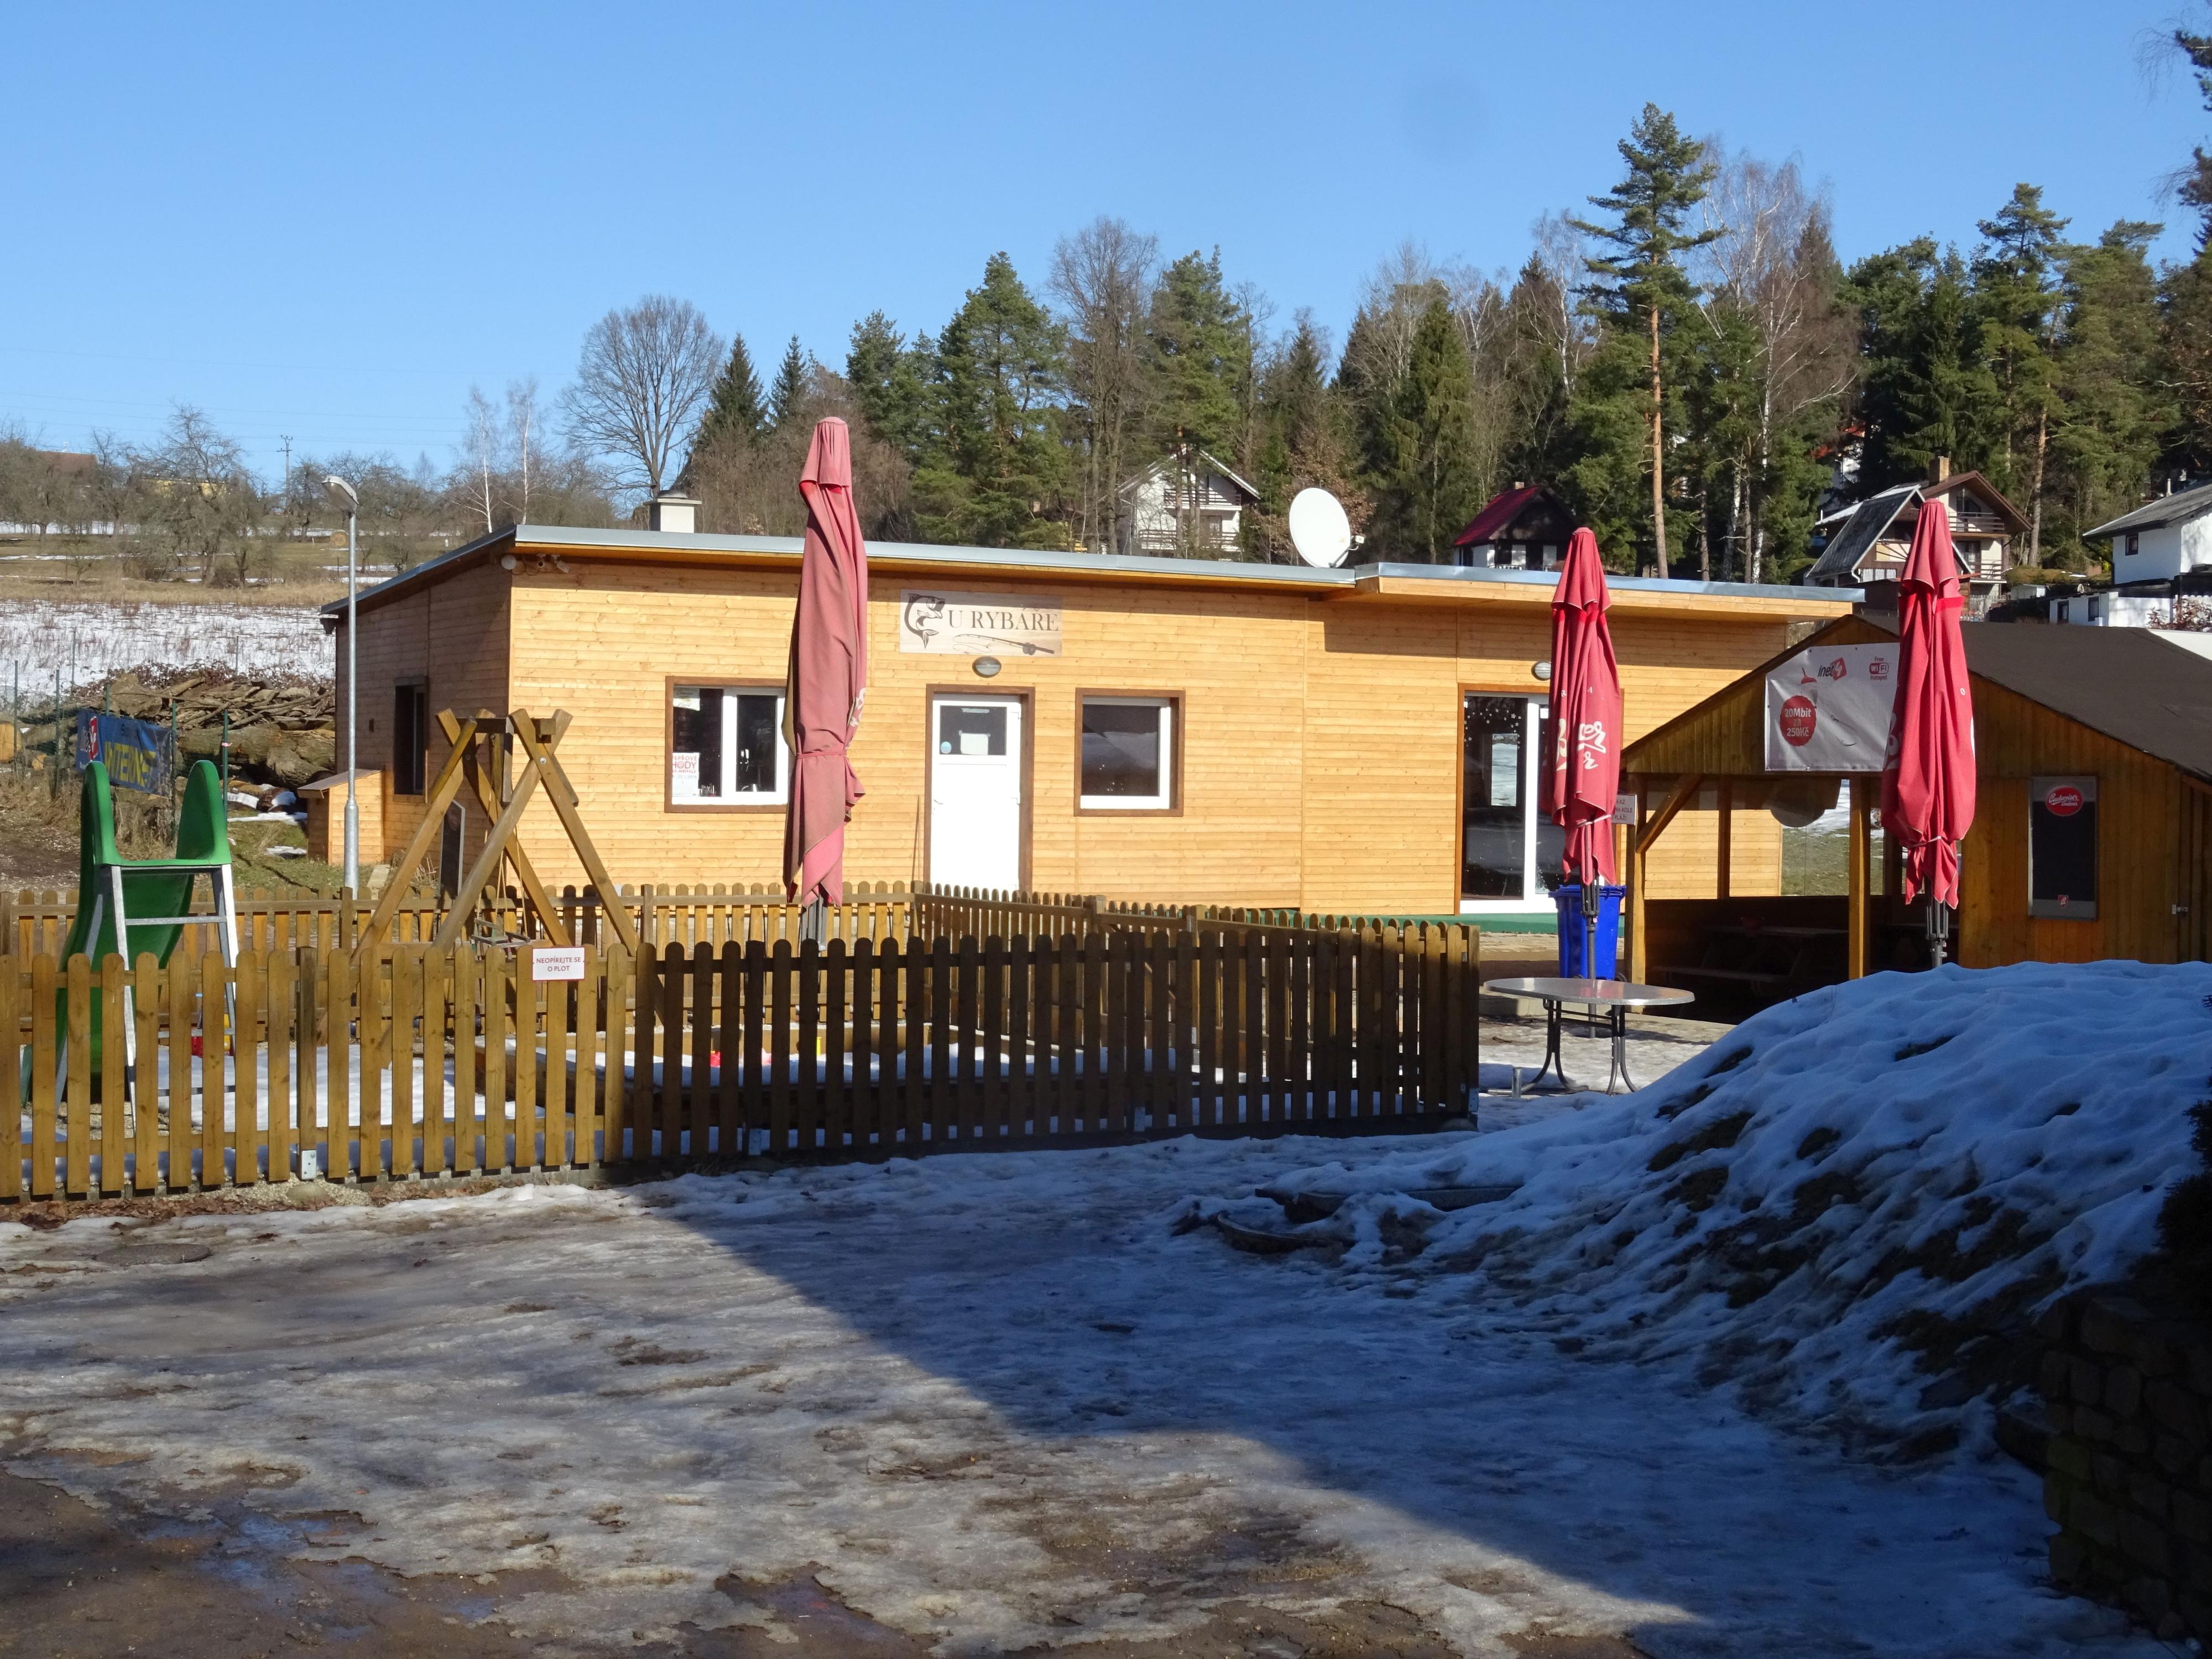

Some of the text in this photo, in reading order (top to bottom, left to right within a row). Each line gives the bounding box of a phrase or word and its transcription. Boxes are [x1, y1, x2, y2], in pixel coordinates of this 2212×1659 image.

[948, 607, 1059, 632] U RYBÁŘE
[1785, 707, 1812, 717] 20Mbit
[1787, 726, 1809, 737] 250Kč
[536, 956, 572, 964] NEOPÍREJTE
